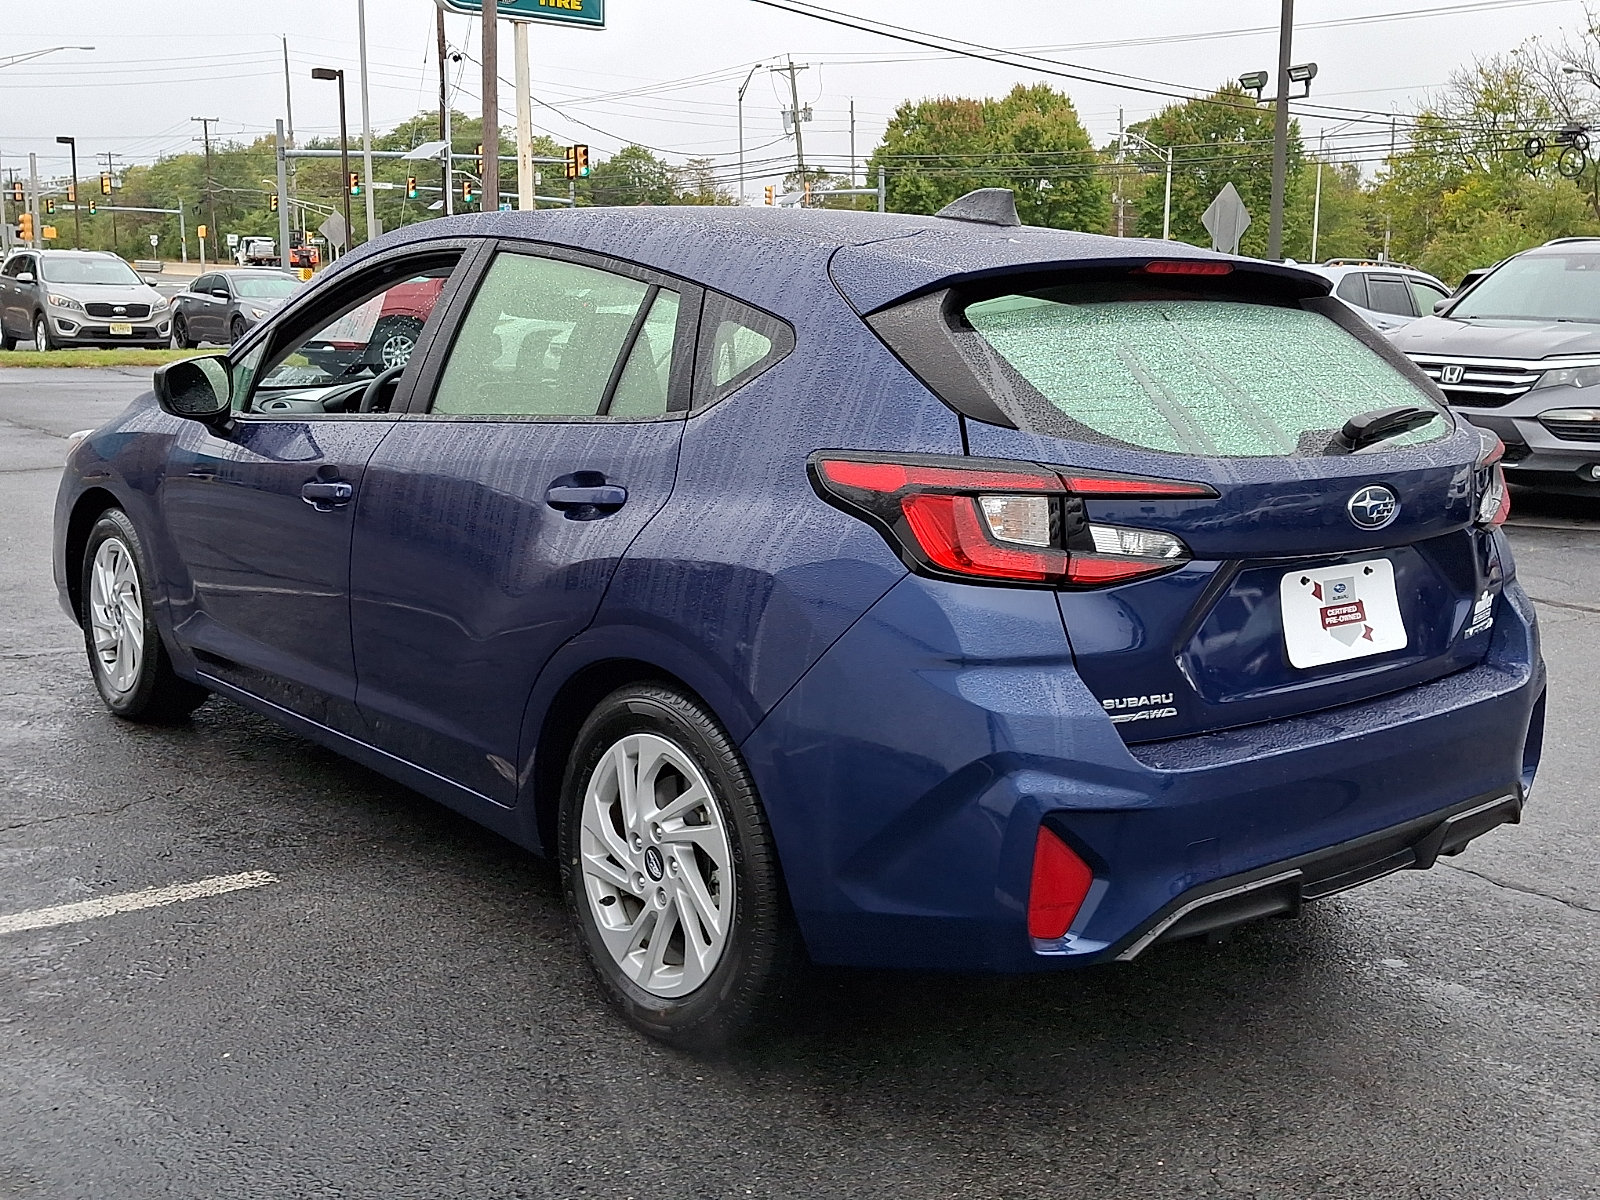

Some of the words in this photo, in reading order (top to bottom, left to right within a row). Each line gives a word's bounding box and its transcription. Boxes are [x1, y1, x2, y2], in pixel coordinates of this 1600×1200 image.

[1327, 605, 1357, 616] CERTIFIED
[1325, 613, 1361, 624] PRE-OWNED
[1103, 693, 1173, 709] SUBARU
[1131, 707, 1178, 721] AWD
